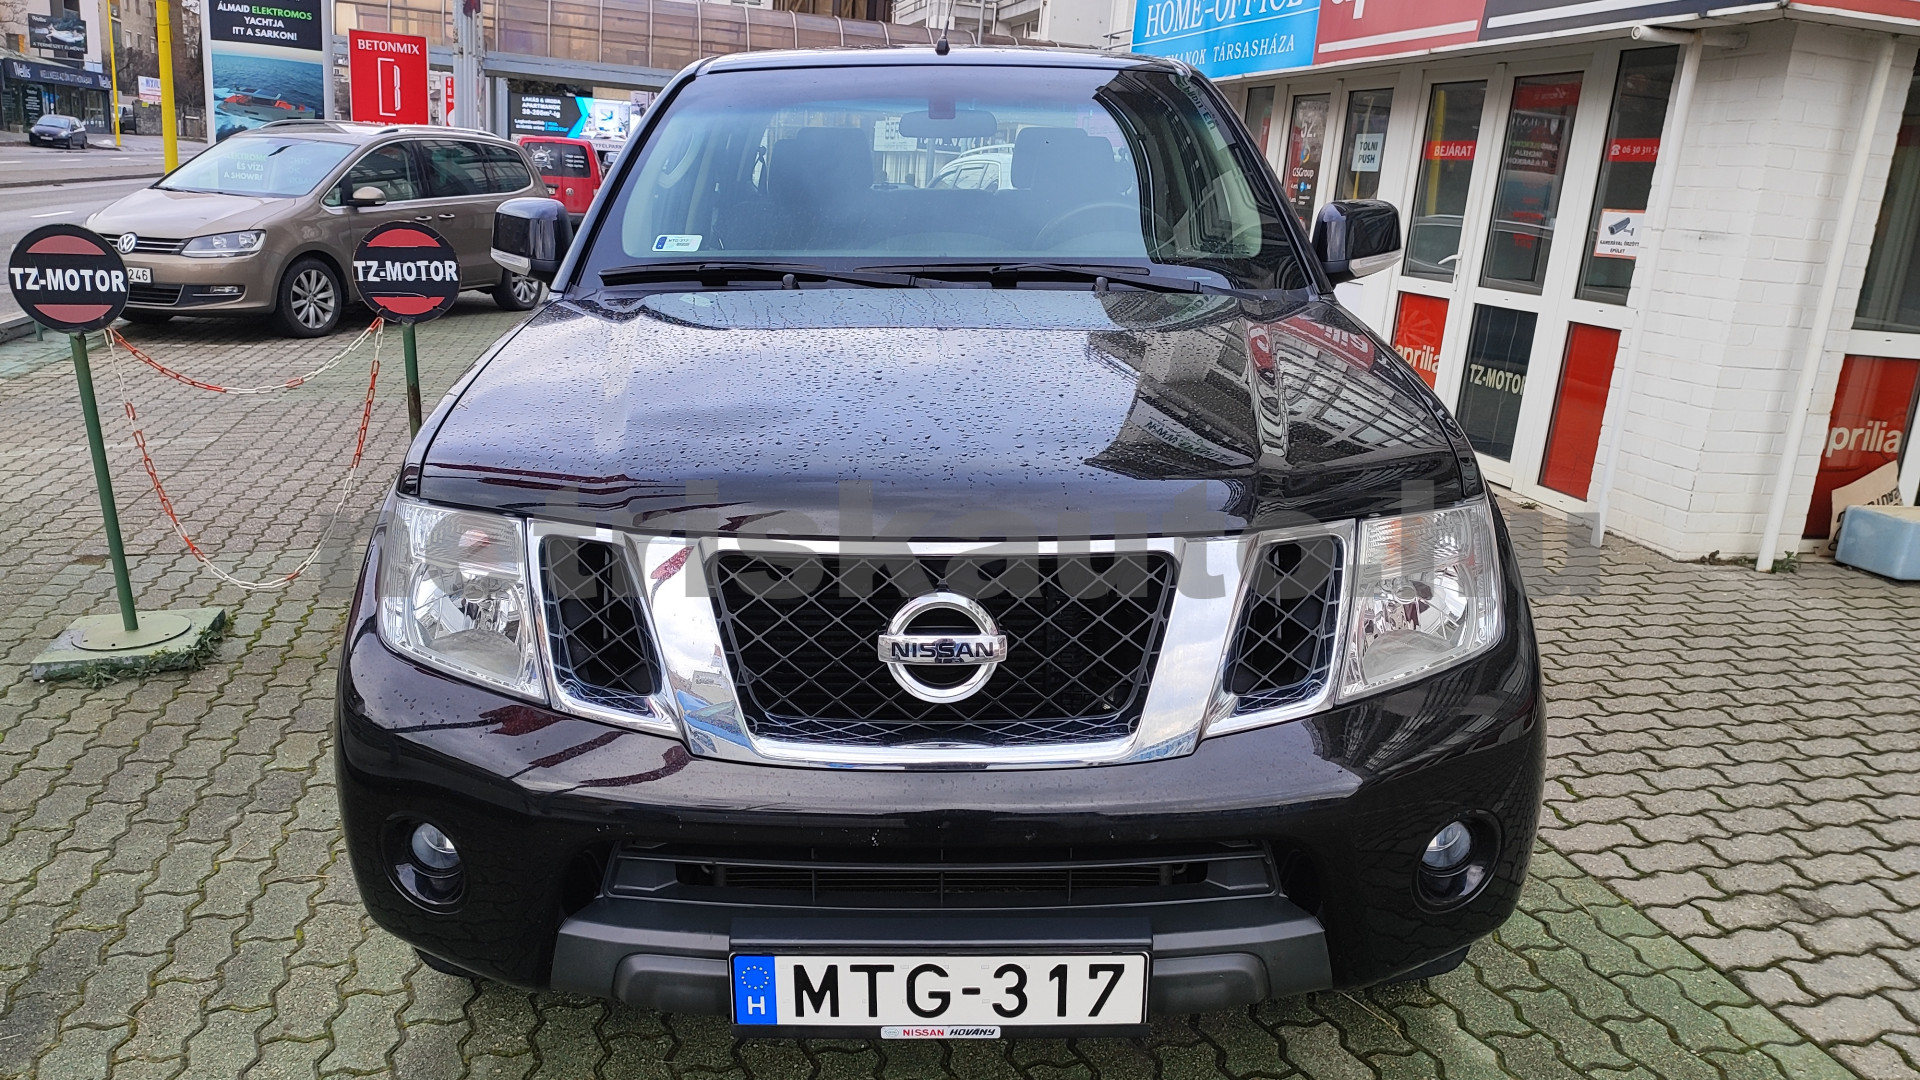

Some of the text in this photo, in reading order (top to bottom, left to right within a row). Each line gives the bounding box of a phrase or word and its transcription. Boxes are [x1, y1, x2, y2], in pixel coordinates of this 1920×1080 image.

[217, 2, 313, 20] ÁLMAID ELEKTROMOS
[244, 16, 285, 28] YACHTJA
[232, 26, 298, 41] ITT A SARKON!
[357, 38, 420, 55] BETONMIX
[1213, 33, 1295, 63] TÁRSASHÁZA
[1359, 141, 1379, 151] TOLNI
[1433, 143, 1473, 157] BEJÁRAT
[1357, 154, 1376, 164] PUSH
[128, 268, 148, 281] 246
[353, 260, 459, 282] TZ-MOTOR
[9, 266, 127, 293] TZ-MOTOR
[1825, 420, 1904, 458] prilia
[891, 642, 994, 658] NISSAN
[747, 963, 1125, 1019] H MTG-317
[902, 1028, 996, 1037] NISSAN HOVÁNY
